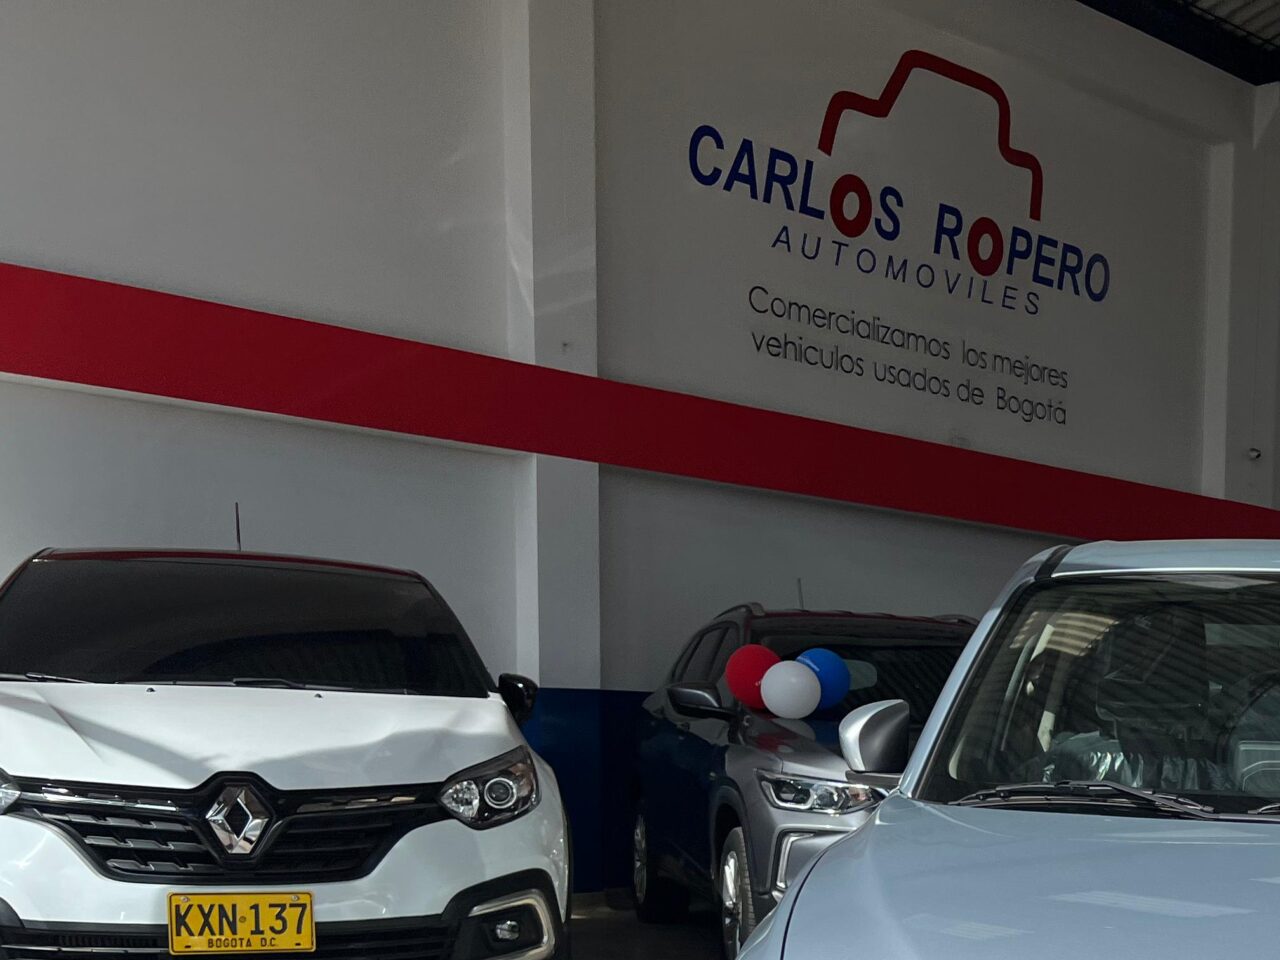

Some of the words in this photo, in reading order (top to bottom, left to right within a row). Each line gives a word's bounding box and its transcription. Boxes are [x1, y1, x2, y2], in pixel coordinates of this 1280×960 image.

[689, 125, 904, 241] CARLOS
[933, 203, 1110, 302] ROPERO
[771, 225, 1041, 315] AUTOMOVILES
[748, 286, 951, 360] Comercializamos
[961, 340, 988, 370] los
[992, 358, 1069, 389] mejores
[872, 363, 951, 398] usados
[956, 379, 985, 405] de
[995, 387, 1068, 425] Bogotá
[175, 903, 238, 936] KXN
[249, 903, 308, 935] 137
[208, 937, 252, 948] BOGOTA
